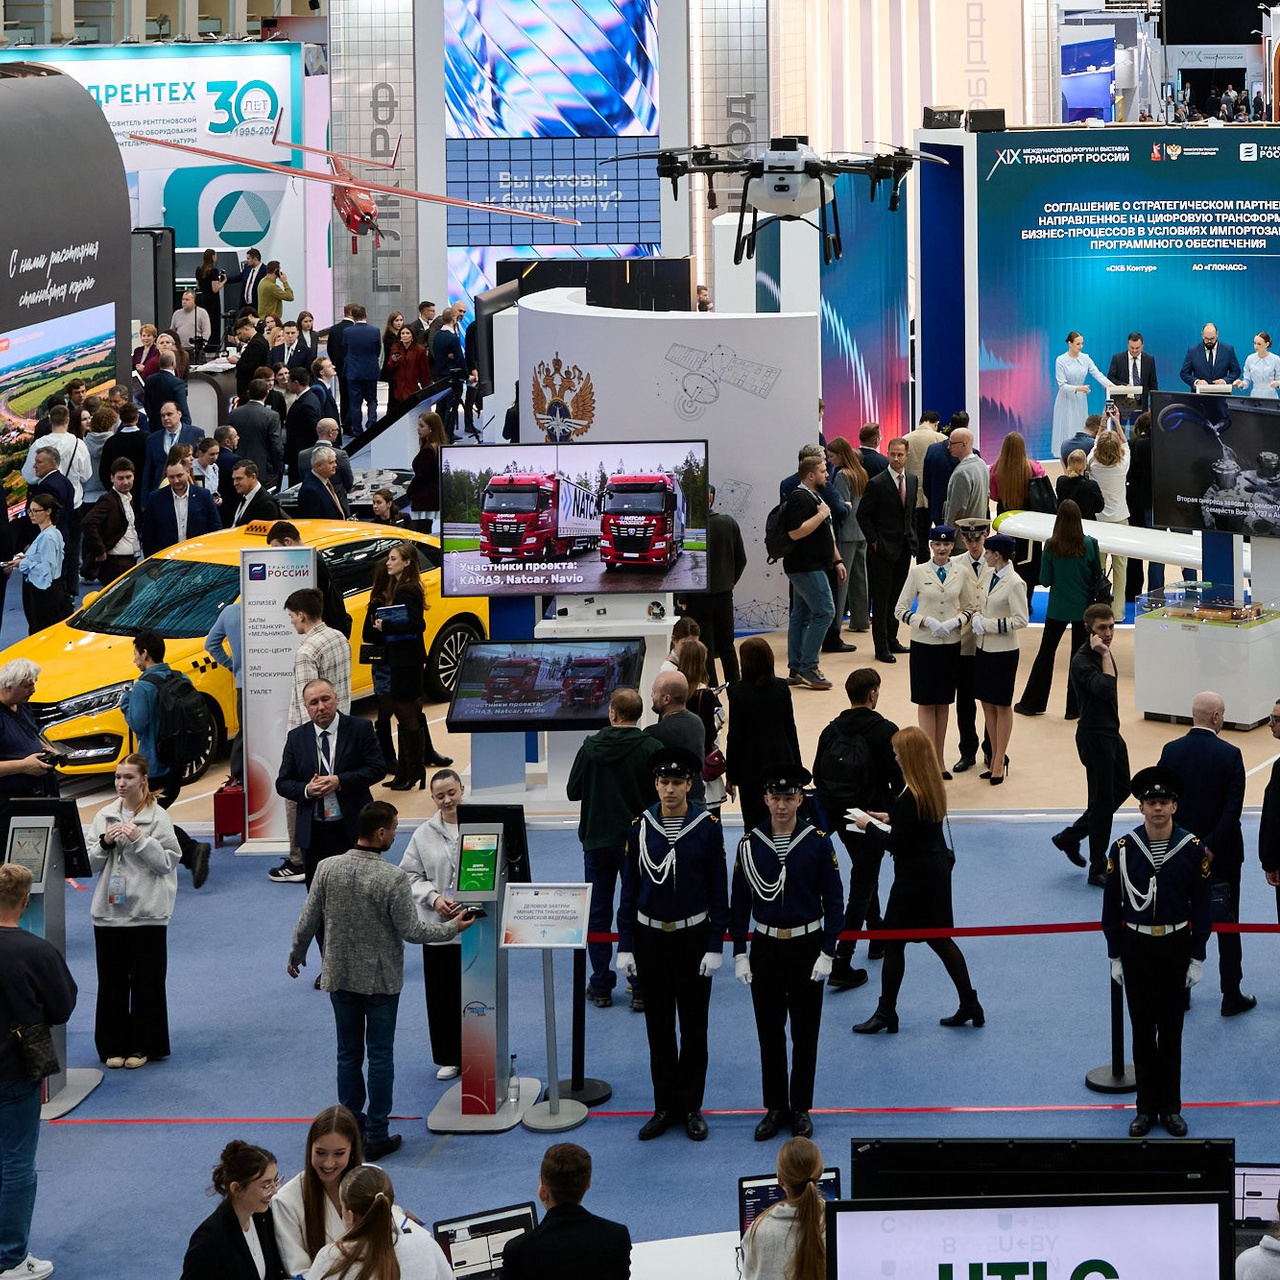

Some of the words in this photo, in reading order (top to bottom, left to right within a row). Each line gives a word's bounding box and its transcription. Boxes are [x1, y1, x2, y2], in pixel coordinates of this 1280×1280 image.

[206, 79, 279, 134] 30
[243, 99, 269, 112] ЛЕТ
[145, 126, 197, 136] ОБОРУДОВАНИЯ
[235, 124, 281, 137] 1995-202
[1022, 153, 1085, 165] ТРАНСПОРТ
[1086, 152, 1130, 163] РОССИИ
[499, 171, 529, 189] Вы
[535, 173, 608, 189] готовы
[502, 190, 623, 212] будущему?
[1043, 201, 1120, 213] СОГЛАШЕНИЕ
[1122, 201, 1131, 211] О
[1132, 200, 1234, 211] СТРАТЕГИЧЕСКОМ
[1038, 214, 1127, 226] НАПРАВЛЕННОЕ
[1129, 214, 1145, 224] НА
[1147, 213, 1213, 225] ЦИФРОВУЮ
[1021, 227, 1136, 240] БИЗНЕС-ПРОЦЕССОВ
[1138, 227, 1145, 236] В
[1147, 226, 1207, 237] УСЛОВИЯХ
[1090, 239, 1184, 250] ПРОГРАММНОГО
[1185, 239, 1267, 249] ОБЕСПЕЧЕНИЯ
[1204, 263, 1247, 271] «ГЛОНАСС»
[1176, 495, 1198, 503] Вторая
[1235, 508, 1256, 517] Boeing
[1256, 509, 1268, 518] 737
[459, 562, 523, 572] Участники
[524, 560, 578, 572] проекта:
[267, 569, 310, 578] РОССИИ
[459, 575, 503, 586] КАМАЗ,
[505, 574, 549, 586] Natcar,
[551, 573, 584, 584] Navio
